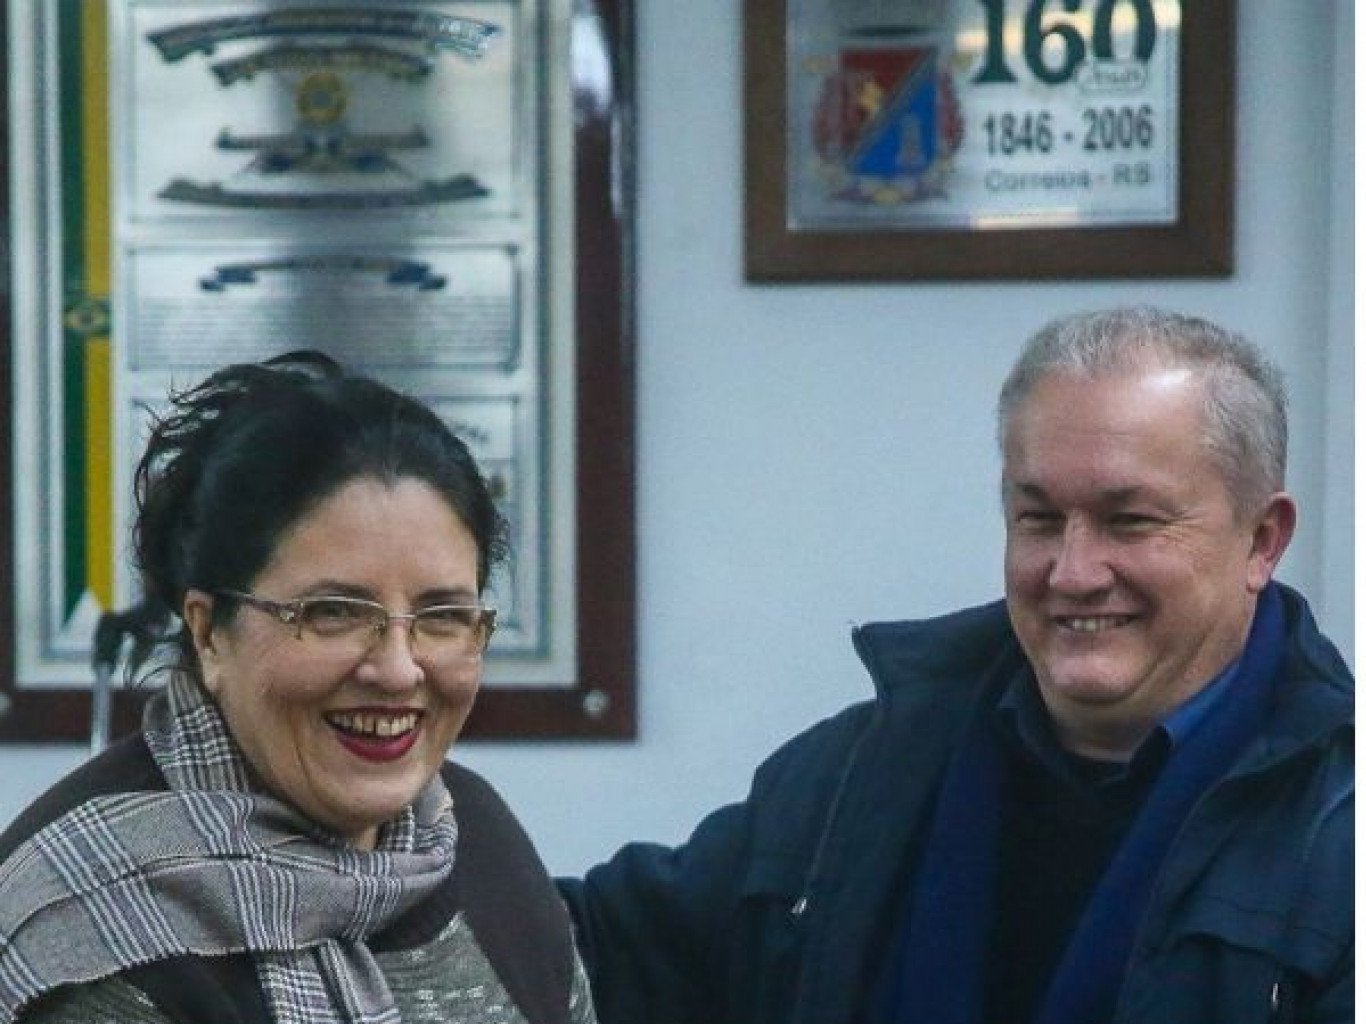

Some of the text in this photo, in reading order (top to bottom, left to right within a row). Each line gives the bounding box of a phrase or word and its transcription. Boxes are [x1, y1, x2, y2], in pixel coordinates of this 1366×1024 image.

[972, 0, 1157, 85] 160
[984, 112, 1053, 156] 1846
[1083, 105, 1155, 151] 2006
[1112, 162, 1151, 184] RS
